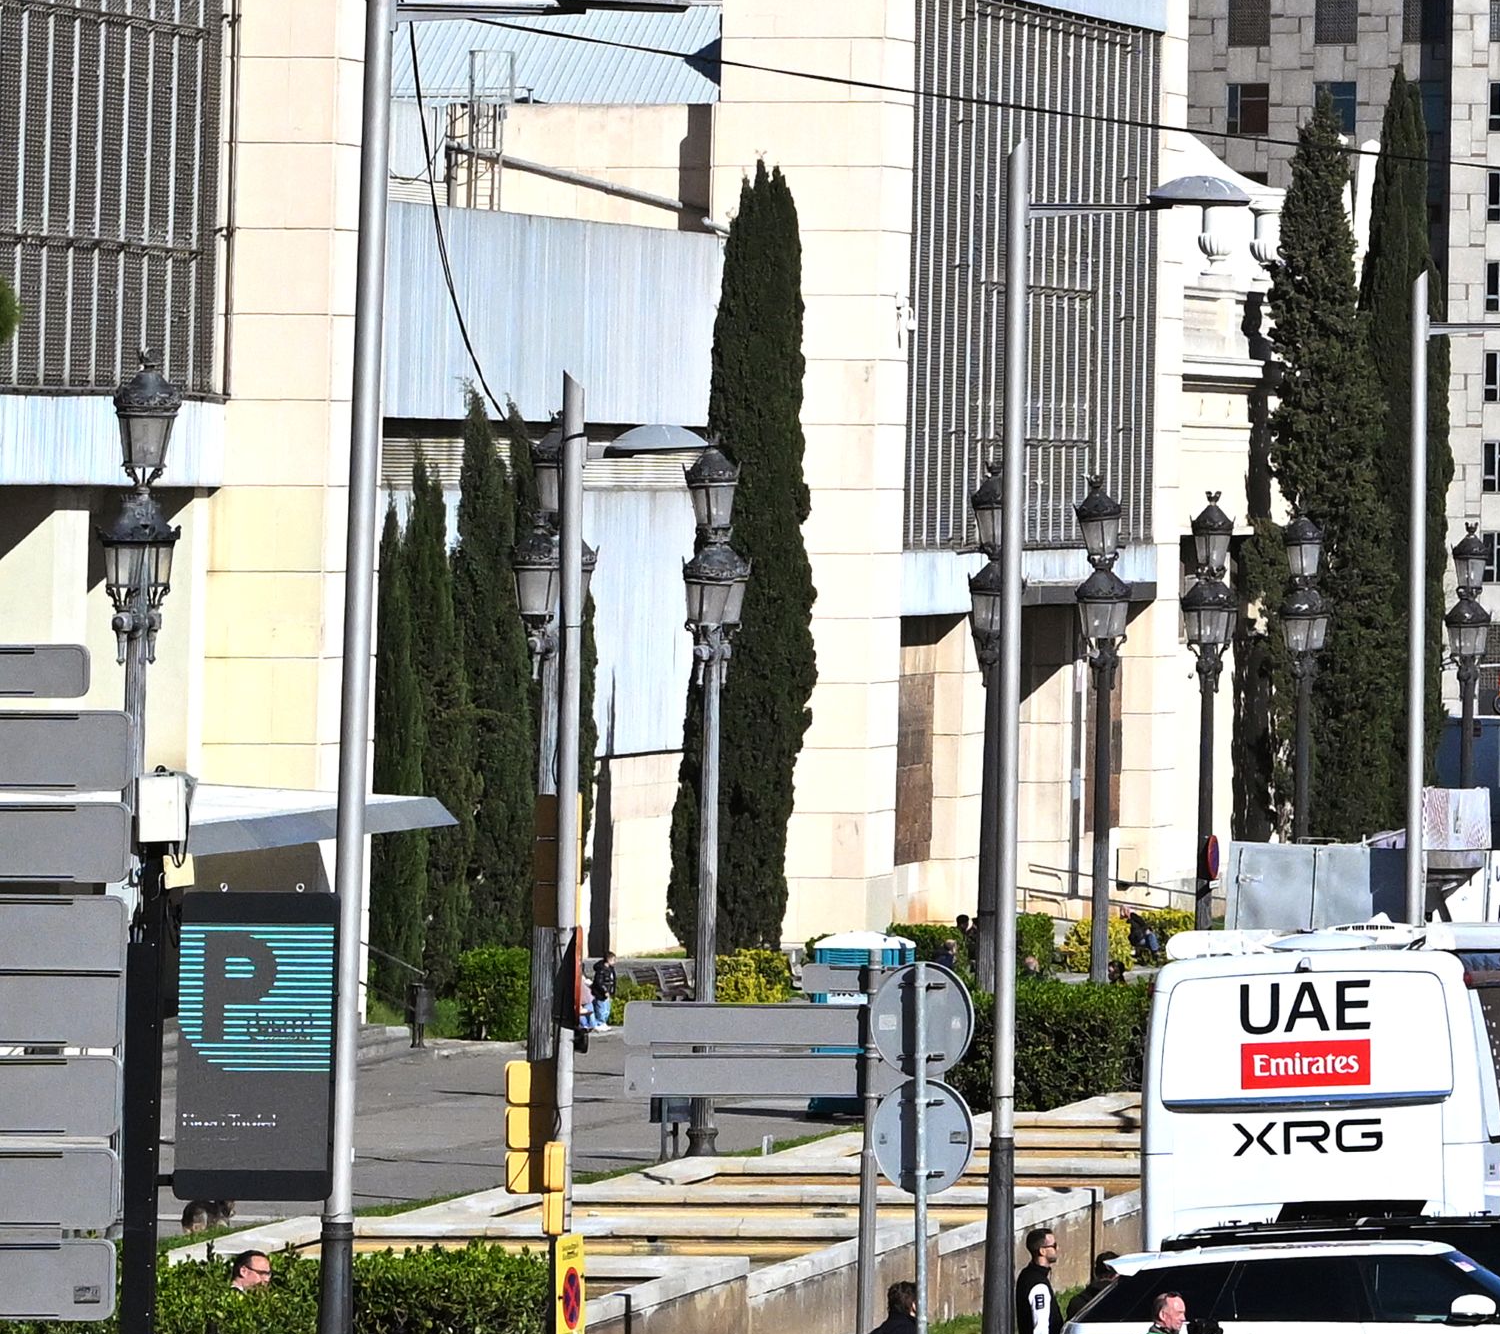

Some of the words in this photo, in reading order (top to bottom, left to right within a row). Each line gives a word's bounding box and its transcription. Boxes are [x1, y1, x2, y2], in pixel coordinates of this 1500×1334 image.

[1239, 979, 1371, 1035] UAE
[1252, 1052, 1360, 1077] Emirates
[1232, 1118, 1384, 1157] XRG
